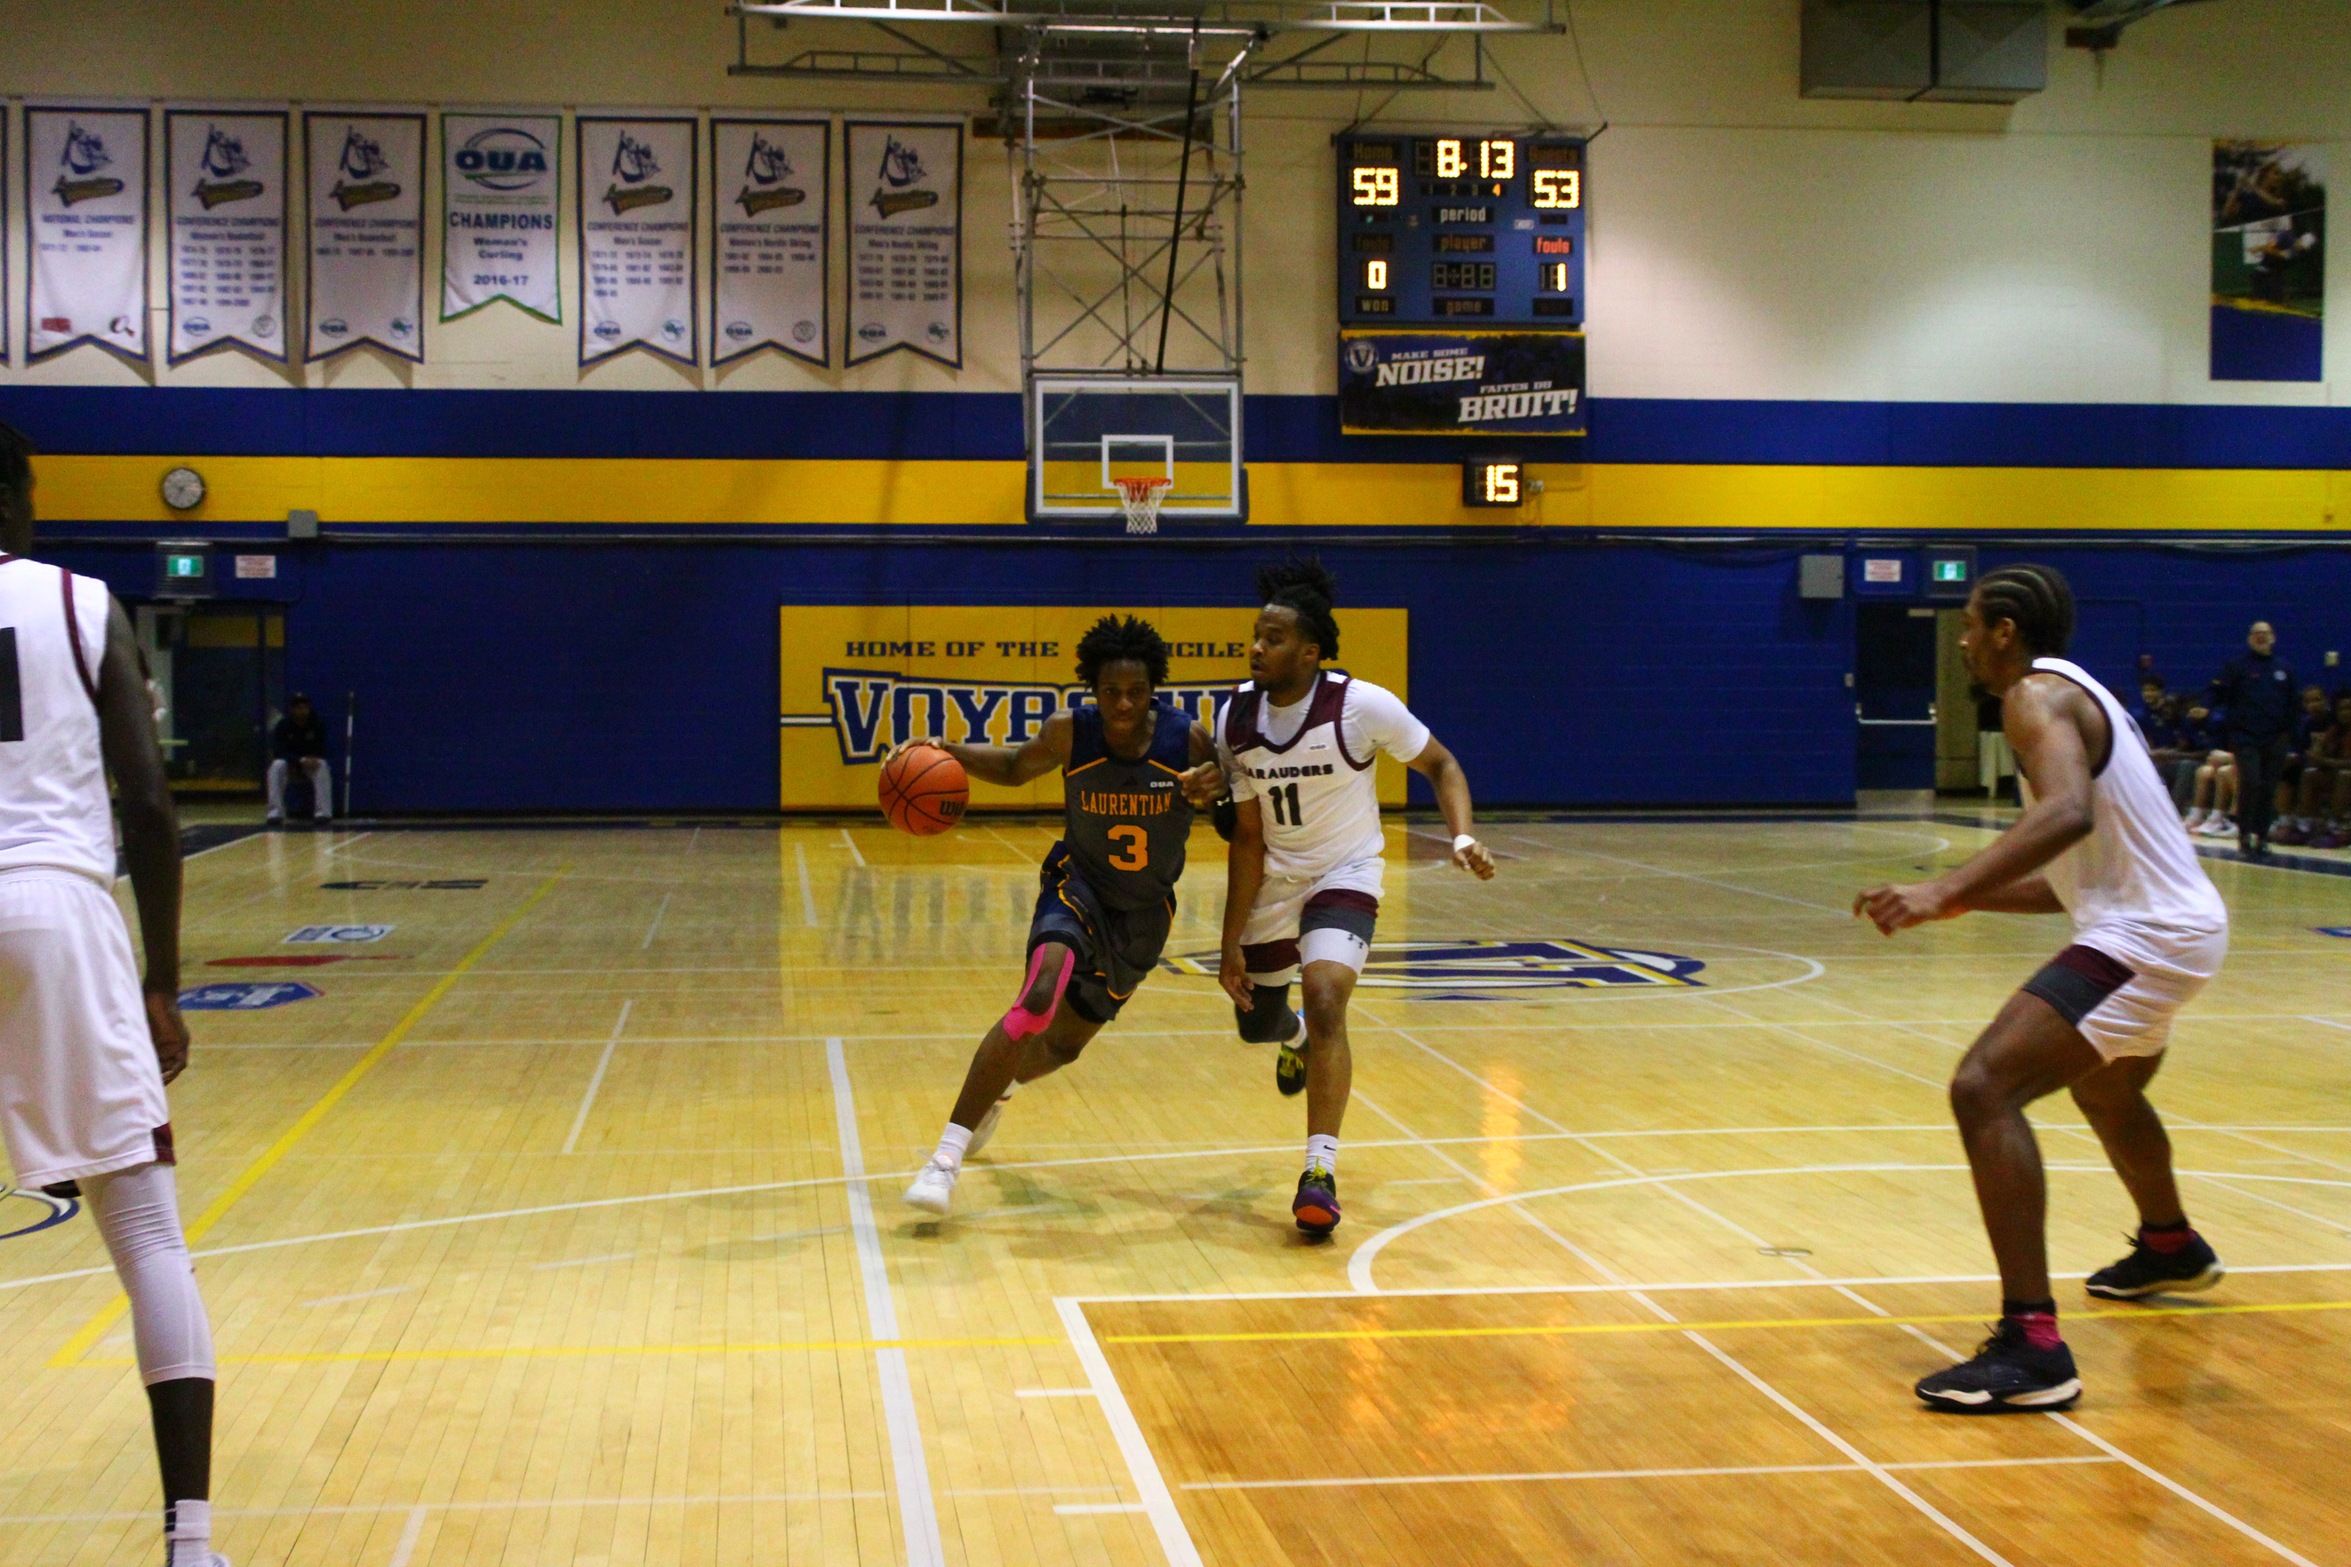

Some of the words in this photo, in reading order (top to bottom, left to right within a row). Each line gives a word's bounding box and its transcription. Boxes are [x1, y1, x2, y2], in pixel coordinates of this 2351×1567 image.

[455, 150, 548, 171] OUA
[1353, 167, 1399, 206] 59
[1534, 170, 1580, 208] 53
[450, 211, 553, 229] CHAMPIONS
[1440, 206, 1487, 223] period
[1537, 236, 1570, 254] fouls
[1368, 260, 1387, 290] 0
[1557, 262, 1567, 292] 1
[1391, 350, 1429, 360] MAKE
[1376, 356, 1485, 387] NOISE!
[1458, 388, 1579, 423] BRUIT!
[1486, 464, 1519, 502] 15
[845, 641, 936, 657] HOME
[946, 641, 985, 657] OF
[996, 641, 1060, 657] THE
[1248, 763, 1334, 779] ARAUDERS
[1081, 790, 1172, 816] LAURENTIAN
[1268, 782, 1302, 826] 11
[1107, 824, 1148, 872] 3
